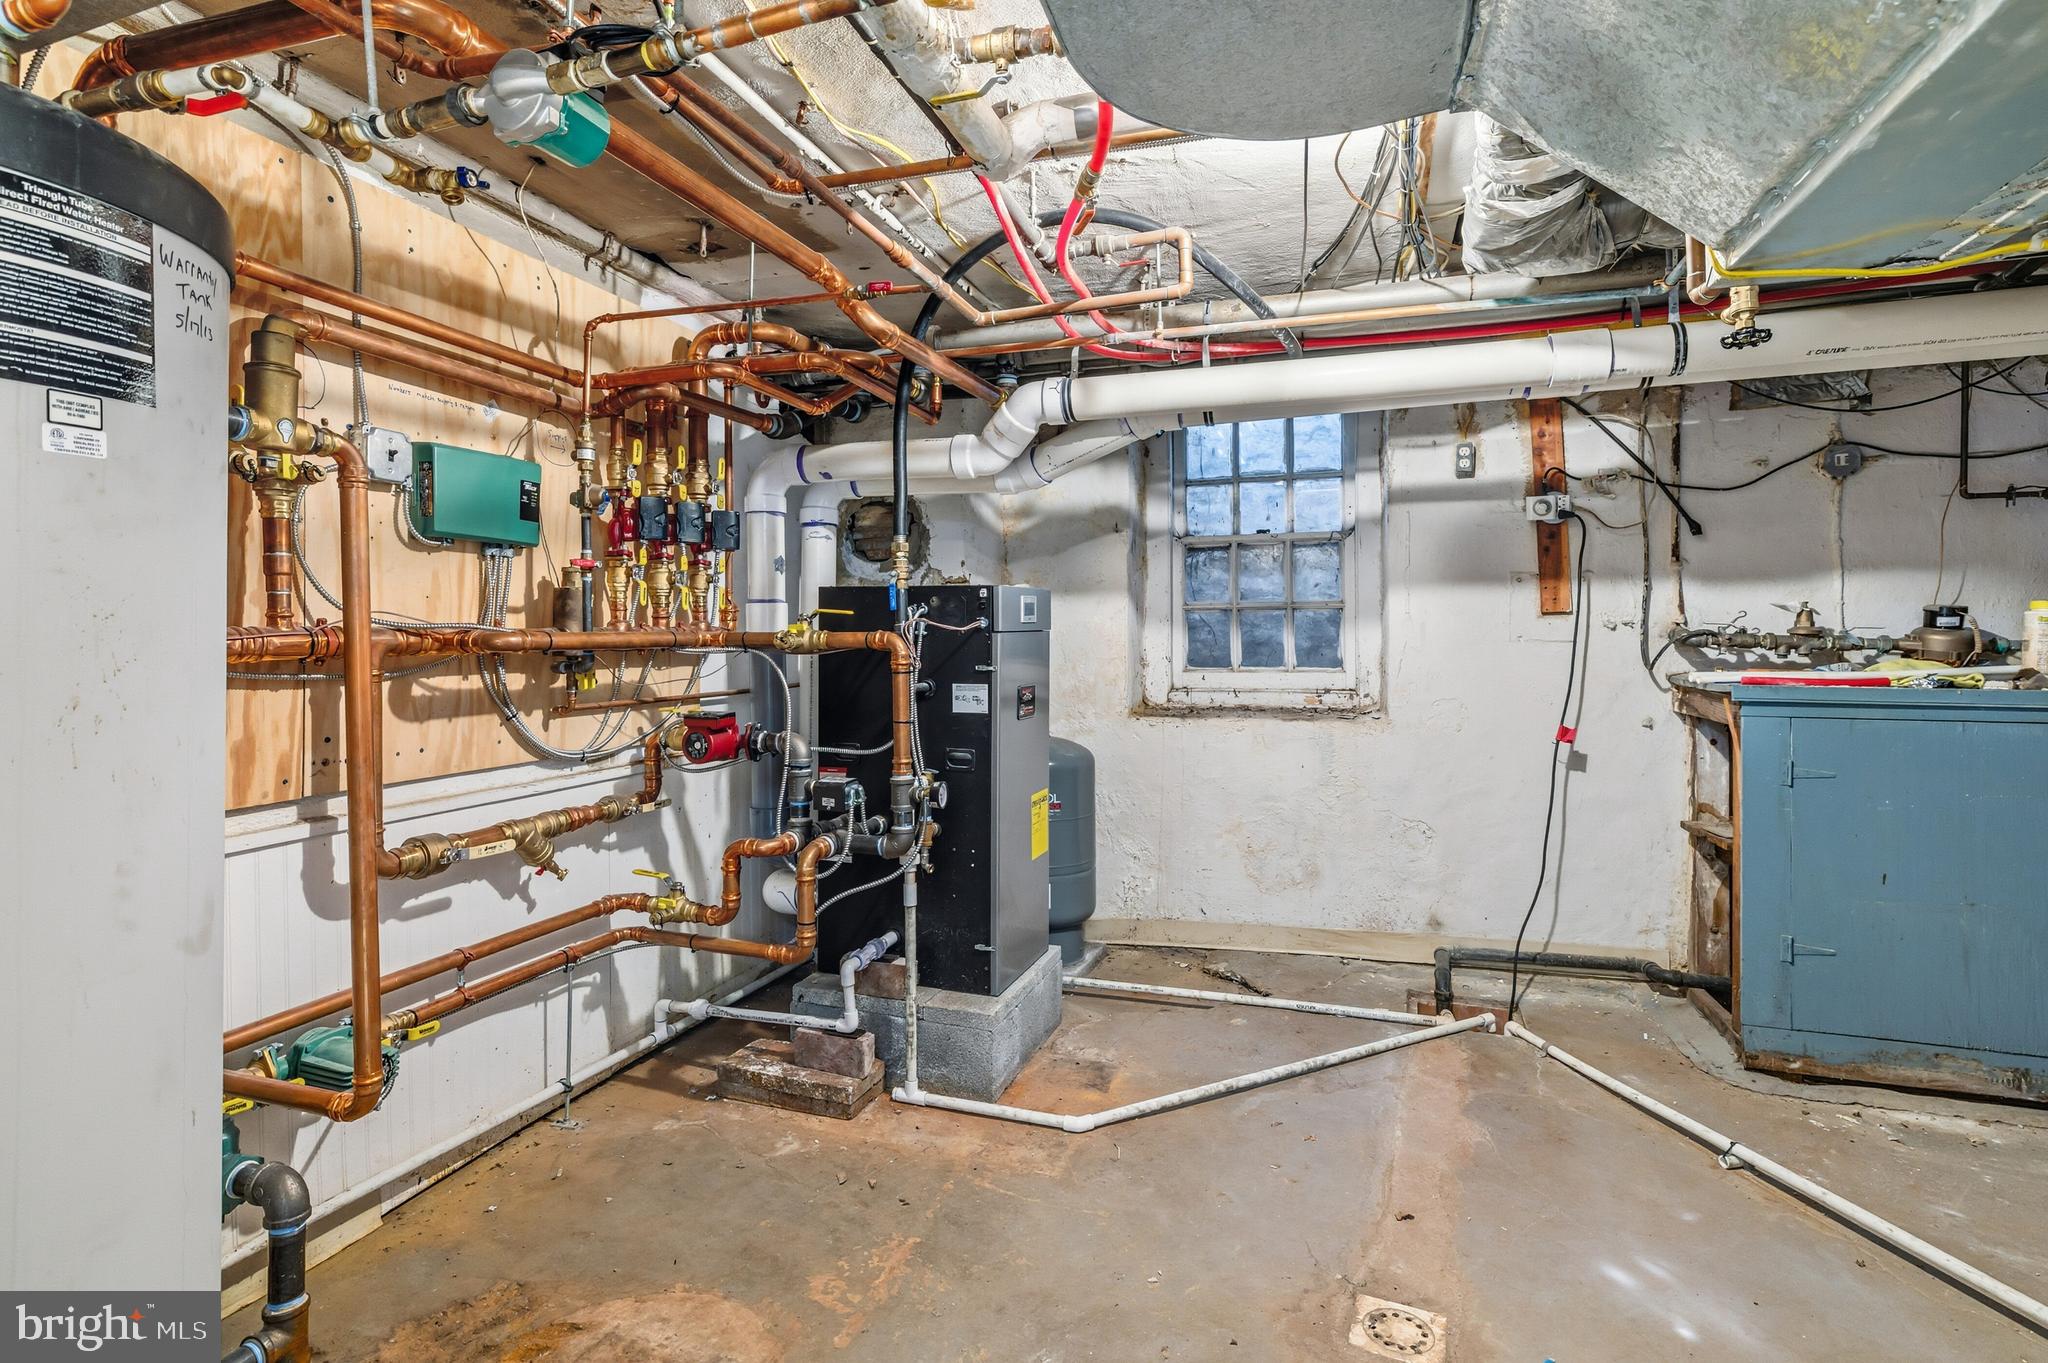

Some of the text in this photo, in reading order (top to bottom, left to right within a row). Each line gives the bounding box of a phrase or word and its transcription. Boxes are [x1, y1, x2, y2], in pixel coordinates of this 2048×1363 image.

[0, 185, 125, 234] irect Fired Water Heater
[20, 181, 94, 213] Triangle Tube
[22, 205, 60, 222] BEFORE
[61, 217, 118, 241] INSTALLATION
[175, 305, 213, 342] 5/17/13
